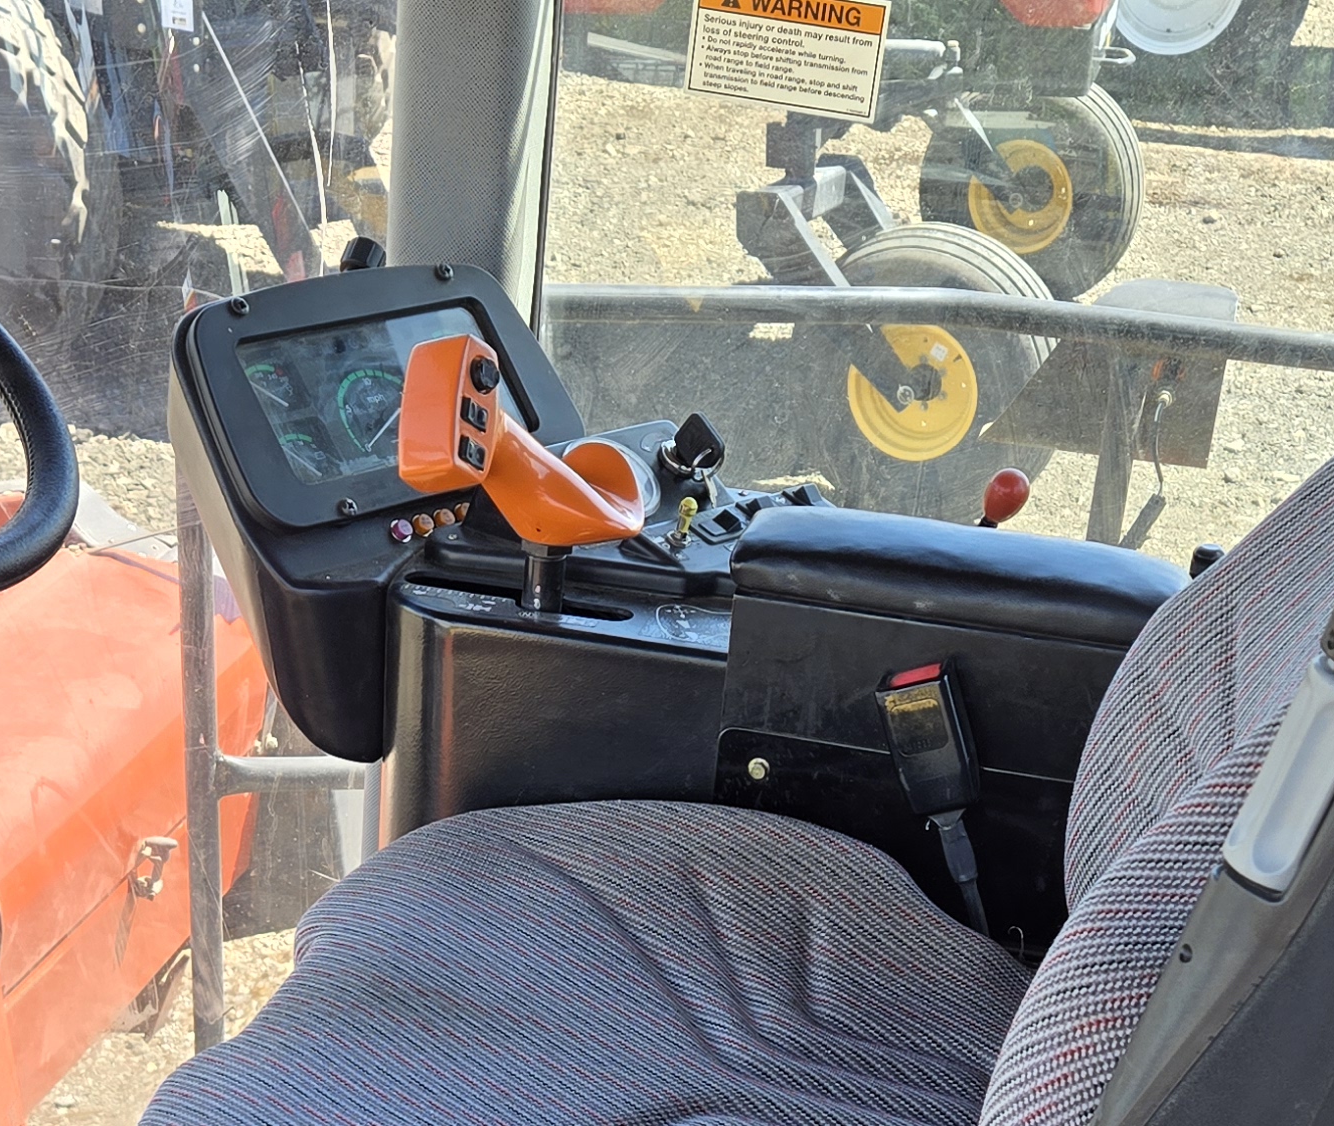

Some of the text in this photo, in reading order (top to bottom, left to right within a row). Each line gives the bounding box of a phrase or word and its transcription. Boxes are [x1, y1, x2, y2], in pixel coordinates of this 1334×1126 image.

[752, 0, 861, 27] WARNING
[702, 24, 805, 47] loss of steering control.
[703, 13, 872, 46] Serious injury or death may result from
[705, 44, 868, 75] Always stop before shifting transmission from
[705, 53, 721, 61] road
[723, 57, 743, 66] range
[754, 61, 770, 69] field
[771, 65, 794, 74] range.
[707, 35, 846, 64] Do not rapidly accelerate while turning.
[702, 80, 748, 93] steep slopes.
[703, 71, 748, 83] transmission
[759, 79, 775, 87] field
[776, 83, 796, 92] range
[798, 86, 821, 95] before
[823, 89, 864, 103] descending
[704, 62, 724, 70] When
[725, 65, 756, 77] traveling
[766, 72, 783, 80] road
[784, 75, 807, 85] range,
[808, 79, 825, 88] stop
[826, 81, 840, 89] and
[842, 83, 857, 91] shift
